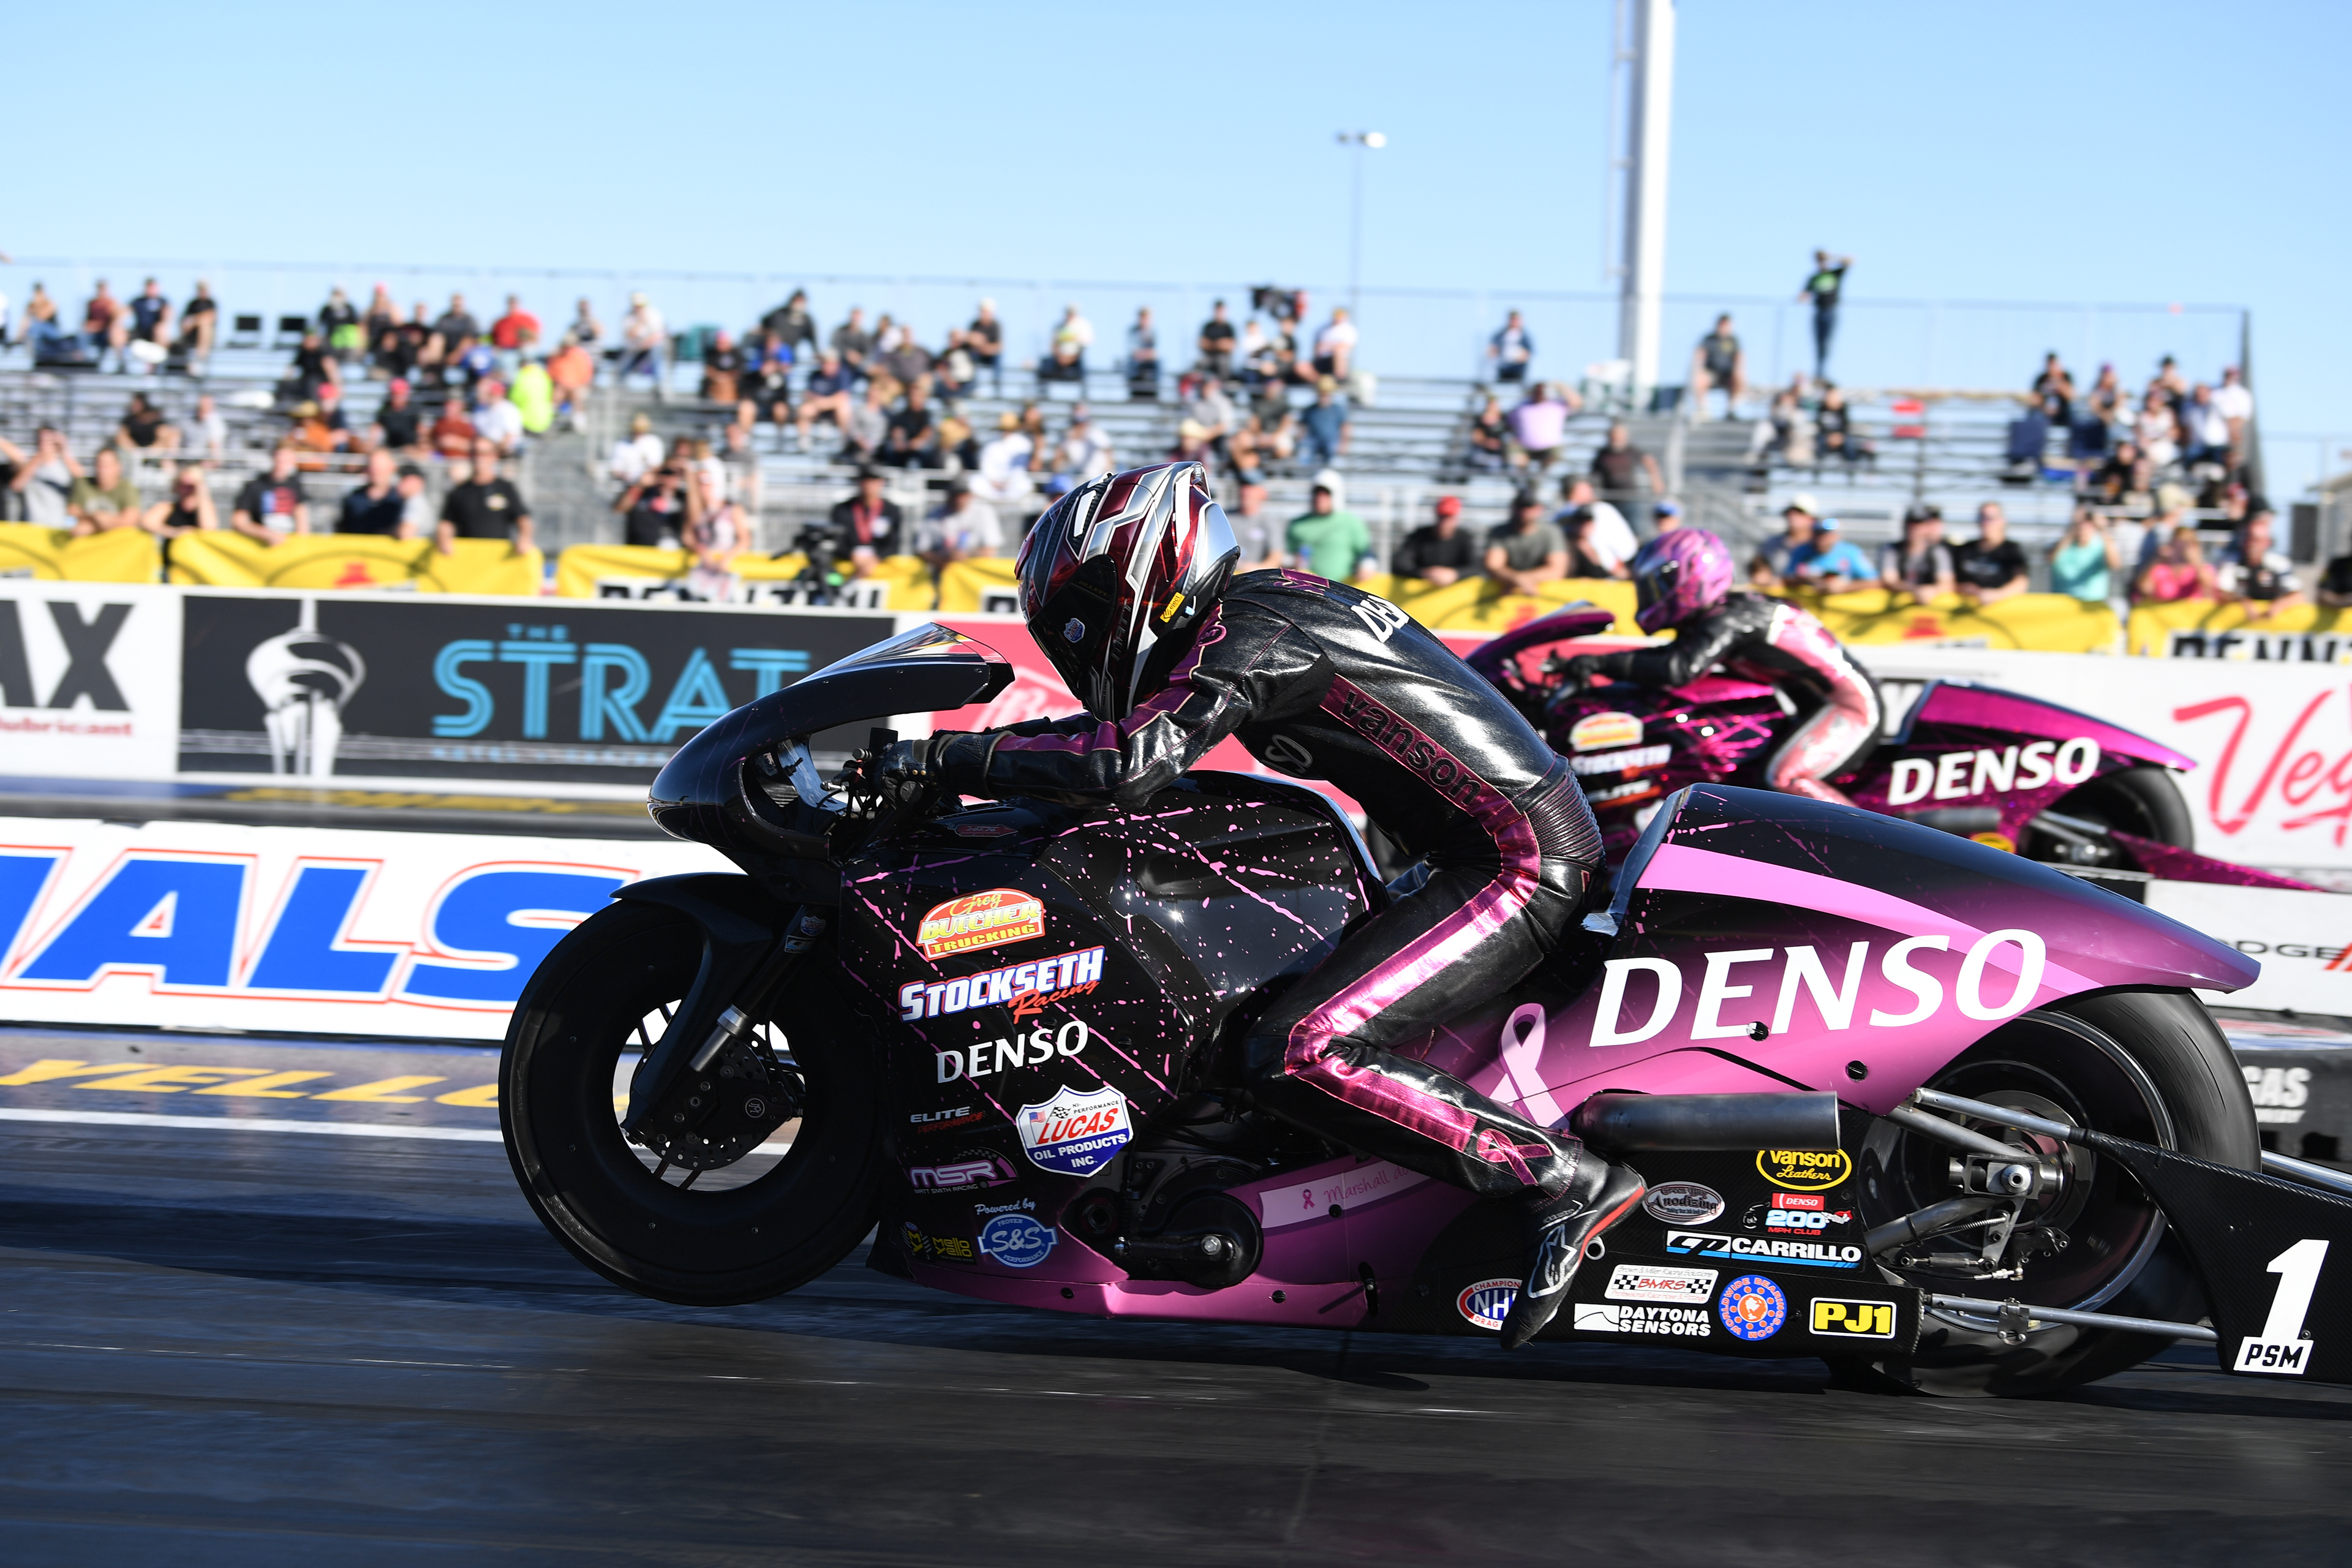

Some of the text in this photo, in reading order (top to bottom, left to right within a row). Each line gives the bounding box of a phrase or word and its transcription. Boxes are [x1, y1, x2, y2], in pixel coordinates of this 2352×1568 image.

[507, 623, 568, 641] THE
[432, 639, 810, 743] STRAT
[1340, 689, 1482, 807] vanson
[1888, 737, 2101, 805] DENSO
[949, 892, 1002, 917] Greg
[921, 901, 1041, 941] BUTCHER
[930, 923, 1037, 954] TRUCKING
[2216, 937, 2347, 963] DGE
[900, 946, 1105, 1022] STOCKSETH
[1589, 929, 2048, 1048] DENSO
[1008, 979, 1099, 1025] Racing
[935, 1020, 1089, 1084] DENSO
[910, 1106, 971, 1123] ELITE
[1074, 1100, 1120, 1115] PERFORMANCE
[1036, 1107, 1118, 1145] LUCAS
[1034, 1133, 1128, 1161] OIL PRODUCTS
[1770, 1150, 1841, 1168] vanson
[1071, 1155, 1098, 1168] INC.
[1776, 1164, 1833, 1181] Leathers
[1324, 1175, 1390, 1203] Marshall
[1785, 1197, 1819, 1206] DENSO
[974, 1197, 1037, 1215] Powered by
[1648, 1194, 1719, 1215] Anodizing
[1765, 1209, 1827, 1229] 200
[1793, 1227, 1822, 1236] CLUB
[991, 1227, 1042, 1253] S&S
[1732, 1237, 1862, 1263] CARRILLO
[1003, 1250, 1044, 1264] PERFORMANCE
[1637, 1278, 1687, 1291] BMRS
[2261, 1238, 2330, 1340] 1
[1619, 1305, 1709, 1323] DAYTONA
[1721, 1277, 1751, 1336] WORLDWIDE
[1813, 1302, 1893, 1334] PJ1
[1474, 1314, 1499, 1329] DRAG
[1619, 1319, 1711, 1336] SENSORS
[2244, 1344, 2305, 1370] PSM
